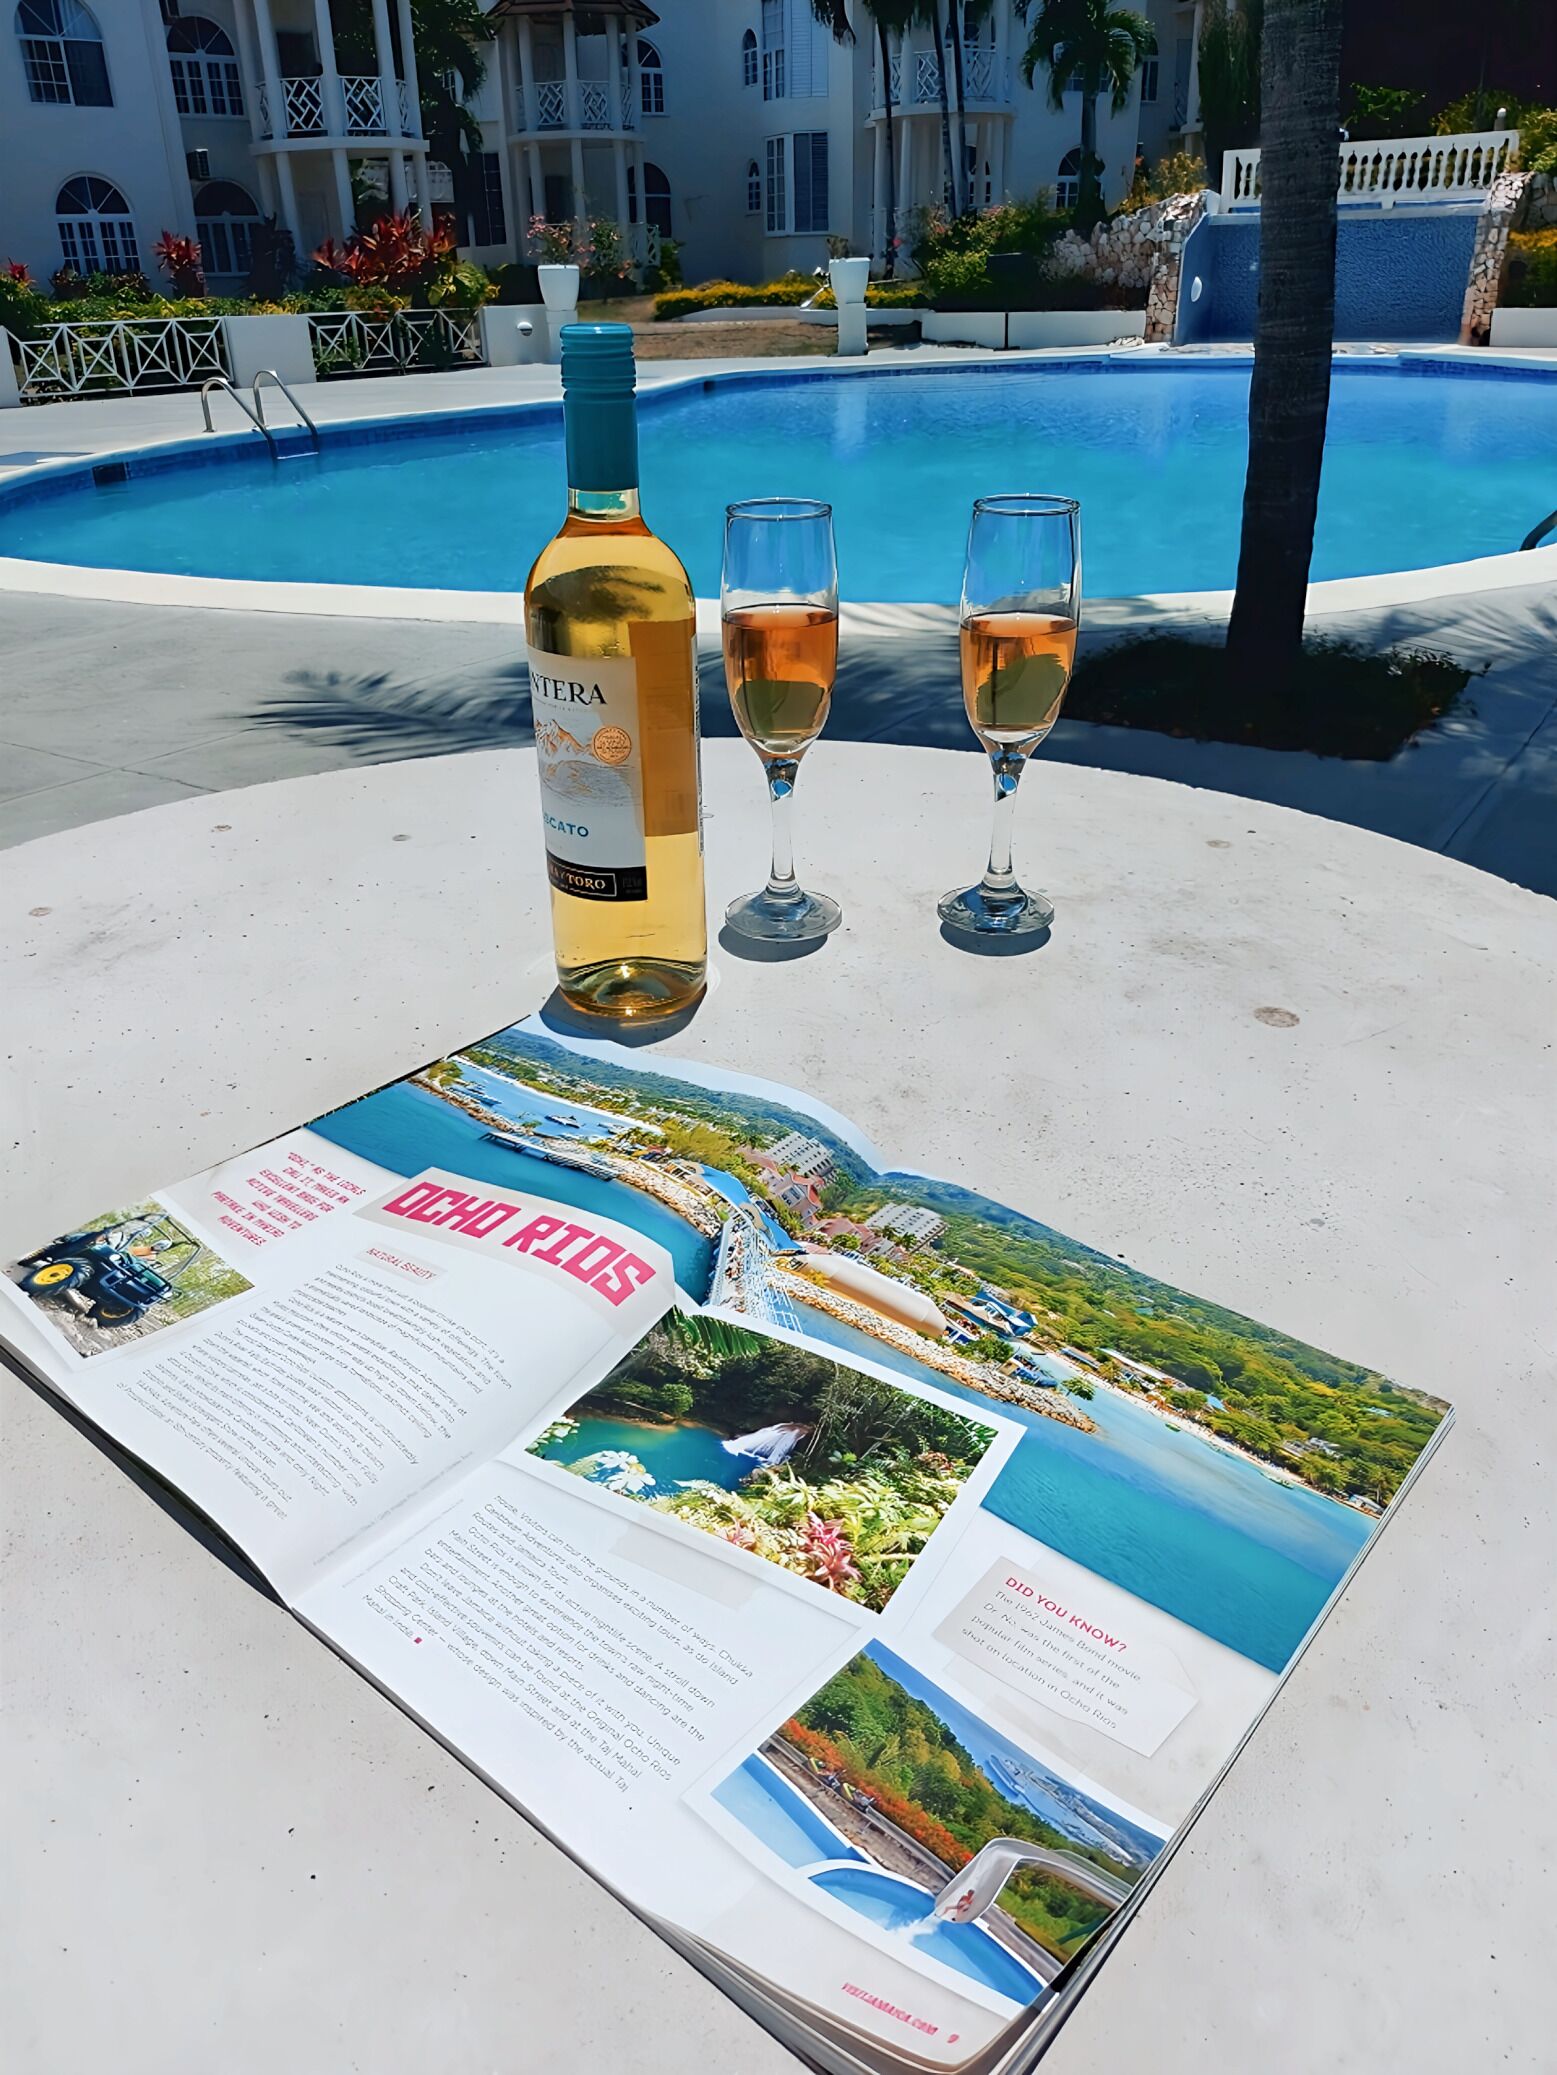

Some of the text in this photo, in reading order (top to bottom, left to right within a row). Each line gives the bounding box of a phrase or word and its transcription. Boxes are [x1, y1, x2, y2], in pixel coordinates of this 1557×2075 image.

[566, 873, 606, 890] TORO
[382, 1181, 656, 1307] OCHO RIOS
[995, 1590, 1013, 1605] The
[1015, 1601, 1038, 1620] 1962
[1039, 1614, 1074, 1644] James
[1076, 1640, 1106, 1661] Bond
[1005, 1577, 1128, 1653] DID YOU KNOW?
[961, 1628, 985, 1645] shot
[987, 1642, 1000, 1655] on
[1001, 1650, 1047, 1685] location
[1047, 1680, 1058, 1692] in
[1060, 1687, 1092, 1713] Ocho
[970, 1614, 1011, 1642] popular
[1013, 1638, 1034, 1658] film
[1071, 1676, 1095, 1695] and
[1096, 1690, 1104, 1700] it
[1106, 1699, 1129, 1715] was
[1042, 1637, 1060, 1654] the
[1062, 1649, 1085, 1669] first
[1087, 1665, 1100, 1675] of
[1102, 1671, 1120, 1689] the
